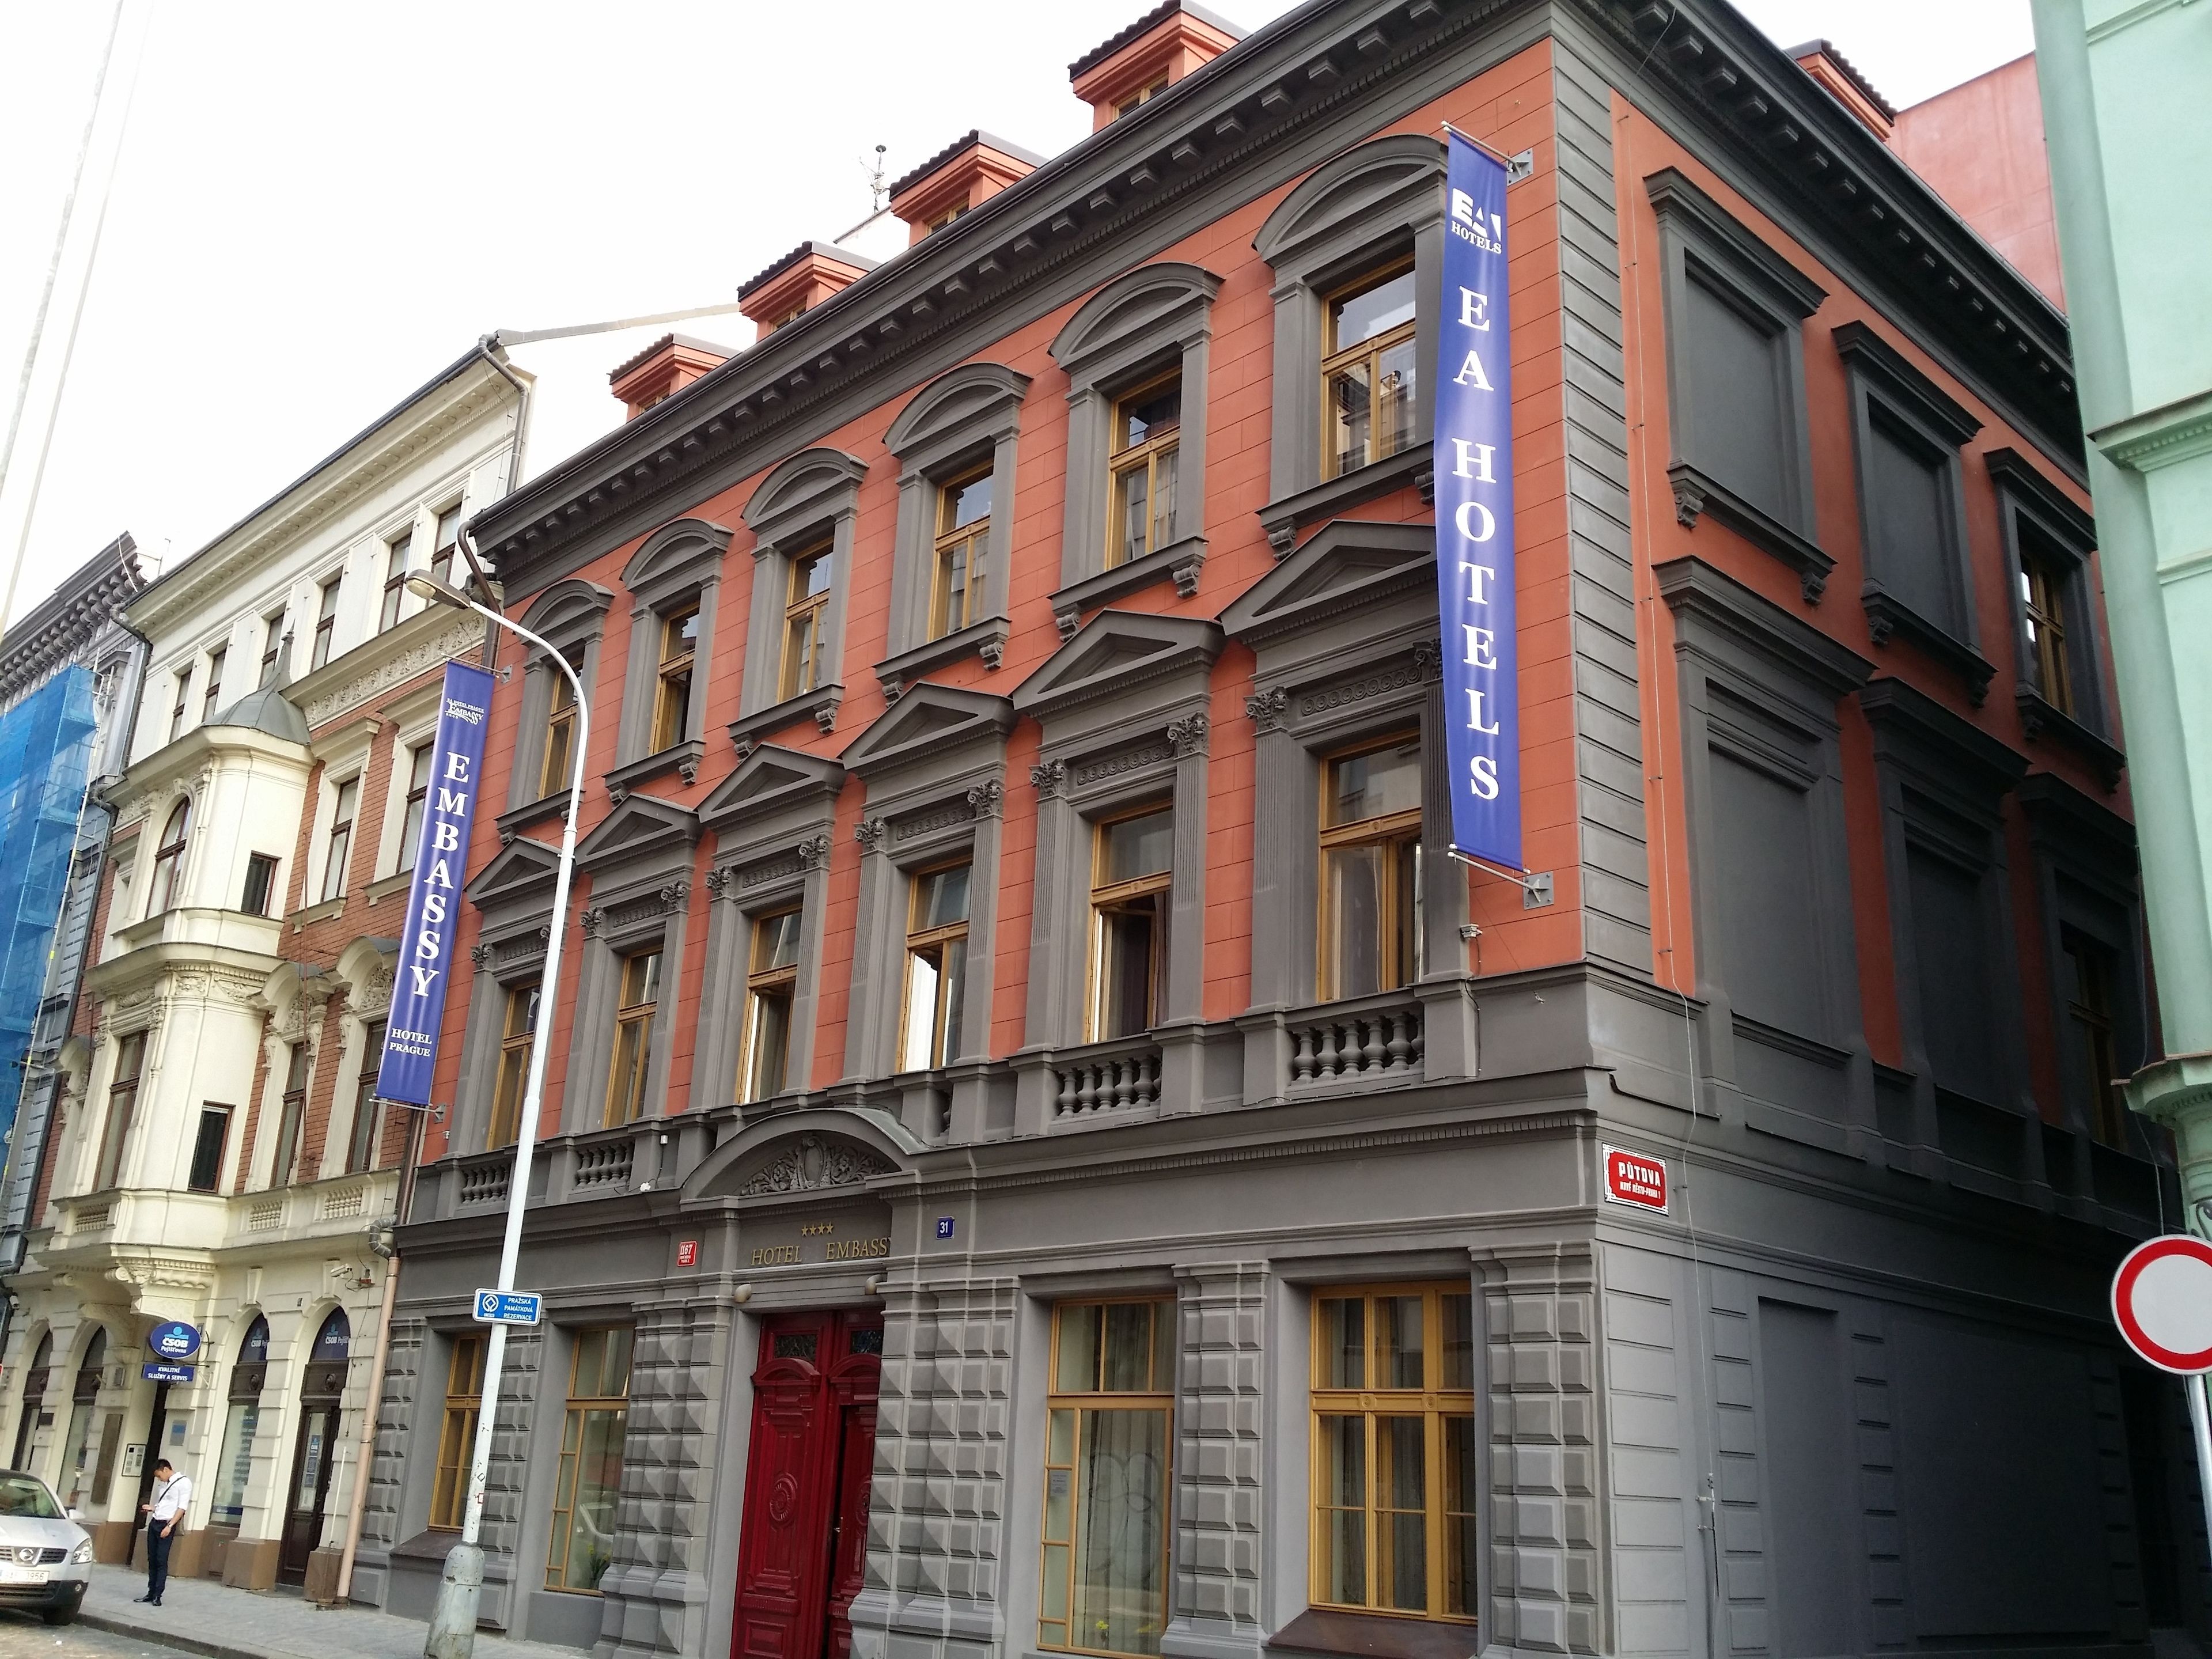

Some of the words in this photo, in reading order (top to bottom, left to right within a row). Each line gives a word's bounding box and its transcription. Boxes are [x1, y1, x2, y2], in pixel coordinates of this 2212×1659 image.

[1451, 220, 1502, 254] HOTELS
[1452, 438, 1499, 800] HOTELS
[448, 702, 484, 725] EMBASSY
[468, 704, 484, 713] PRAGUE
[410, 751, 470, 997] EMBASSY
[391, 1028, 432, 1044] HOTEL
[389, 1041, 430, 1057] PRAGUE
[940, 1221, 948, 1233] 31
[680, 1244, 693, 1255] 1167
[751, 1245, 802, 1266] HOTEL
[826, 1237, 891, 1260] EMBASS
[504, 1305, 533, 1313] PAMÁTKOVÁ
[162, 1337, 188, 1348] ČSOB
